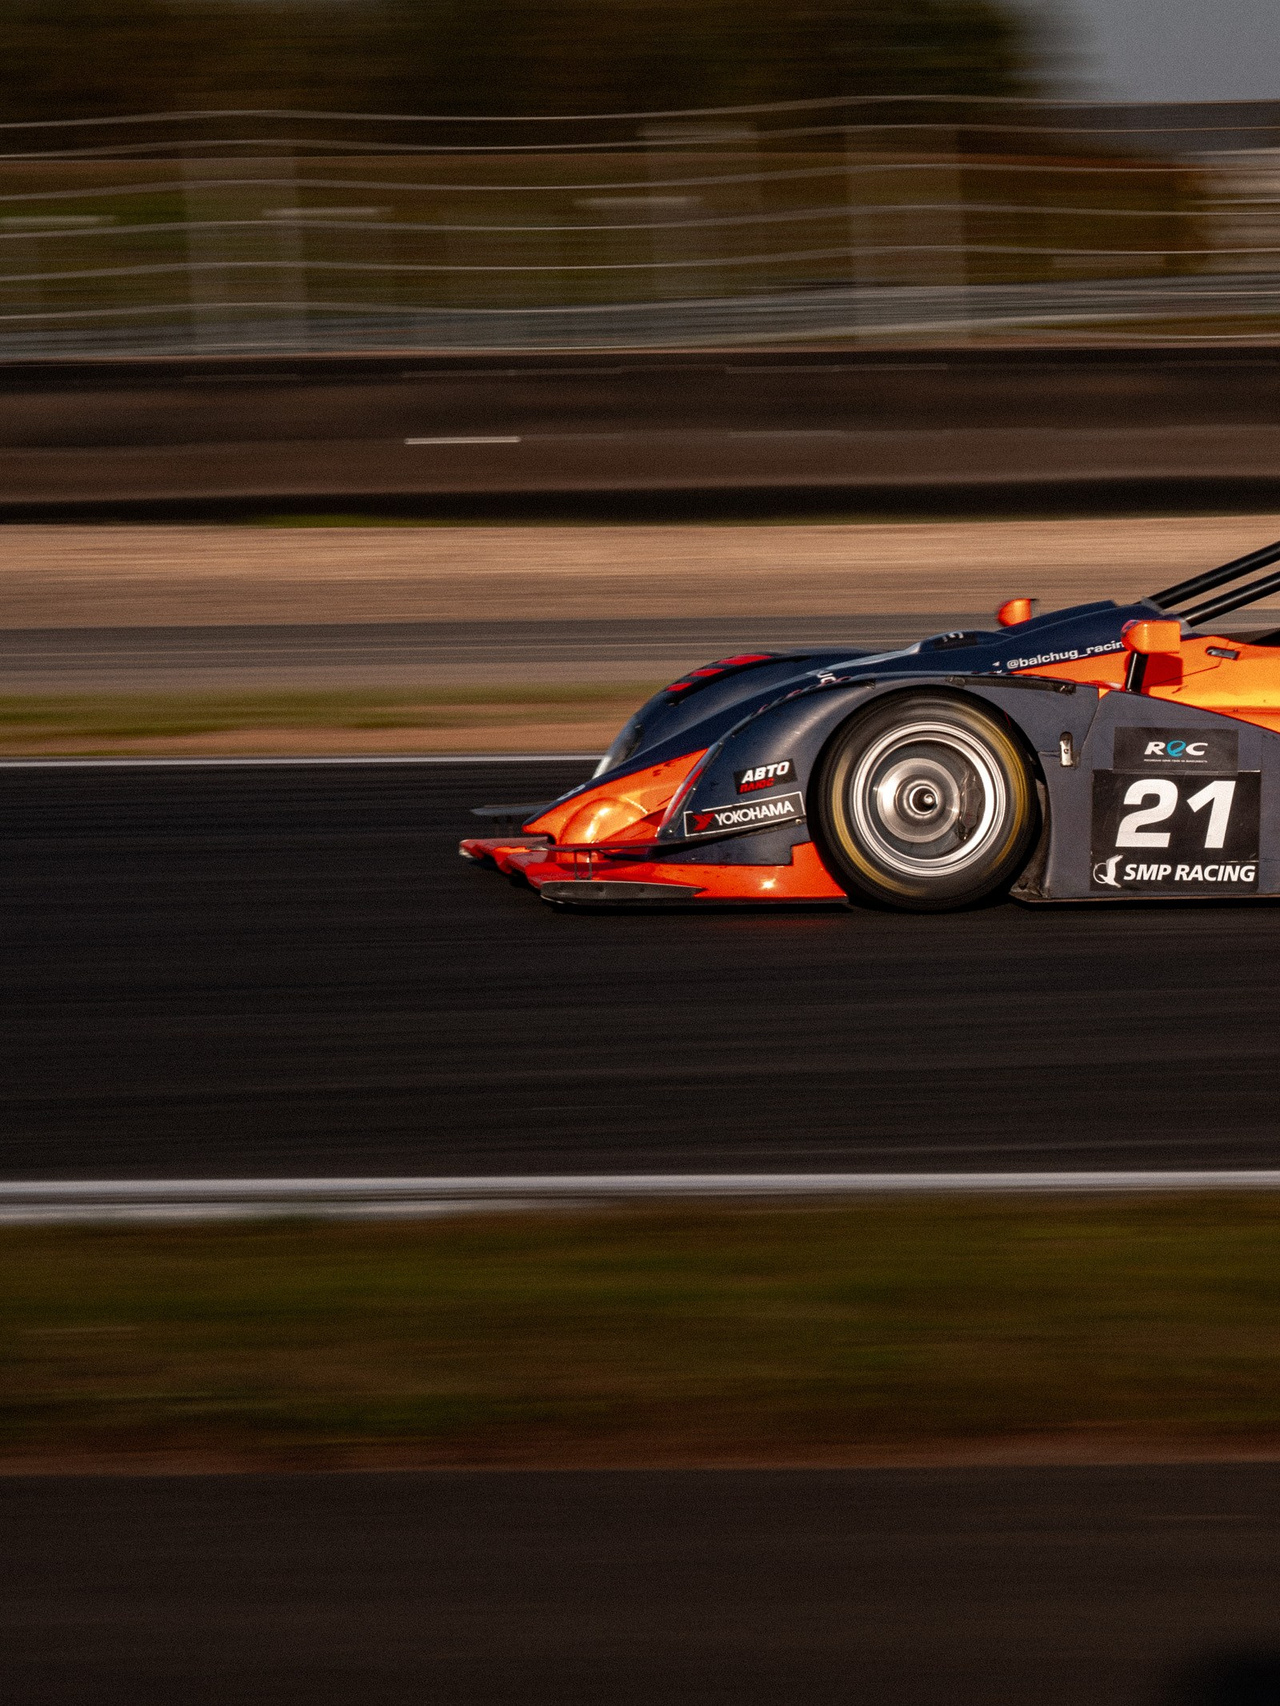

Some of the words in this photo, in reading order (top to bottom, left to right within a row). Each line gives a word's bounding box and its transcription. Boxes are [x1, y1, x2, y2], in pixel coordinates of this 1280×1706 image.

[1006, 640, 1125, 670] @balchug_racin
[741, 761, 790, 784] АВТО
[714, 800, 795, 826] YOKOHAMA
[1115, 778, 1236, 848] 21
[1123, 864, 1172, 881] SMP
[1174, 864, 1256, 882] RACING
